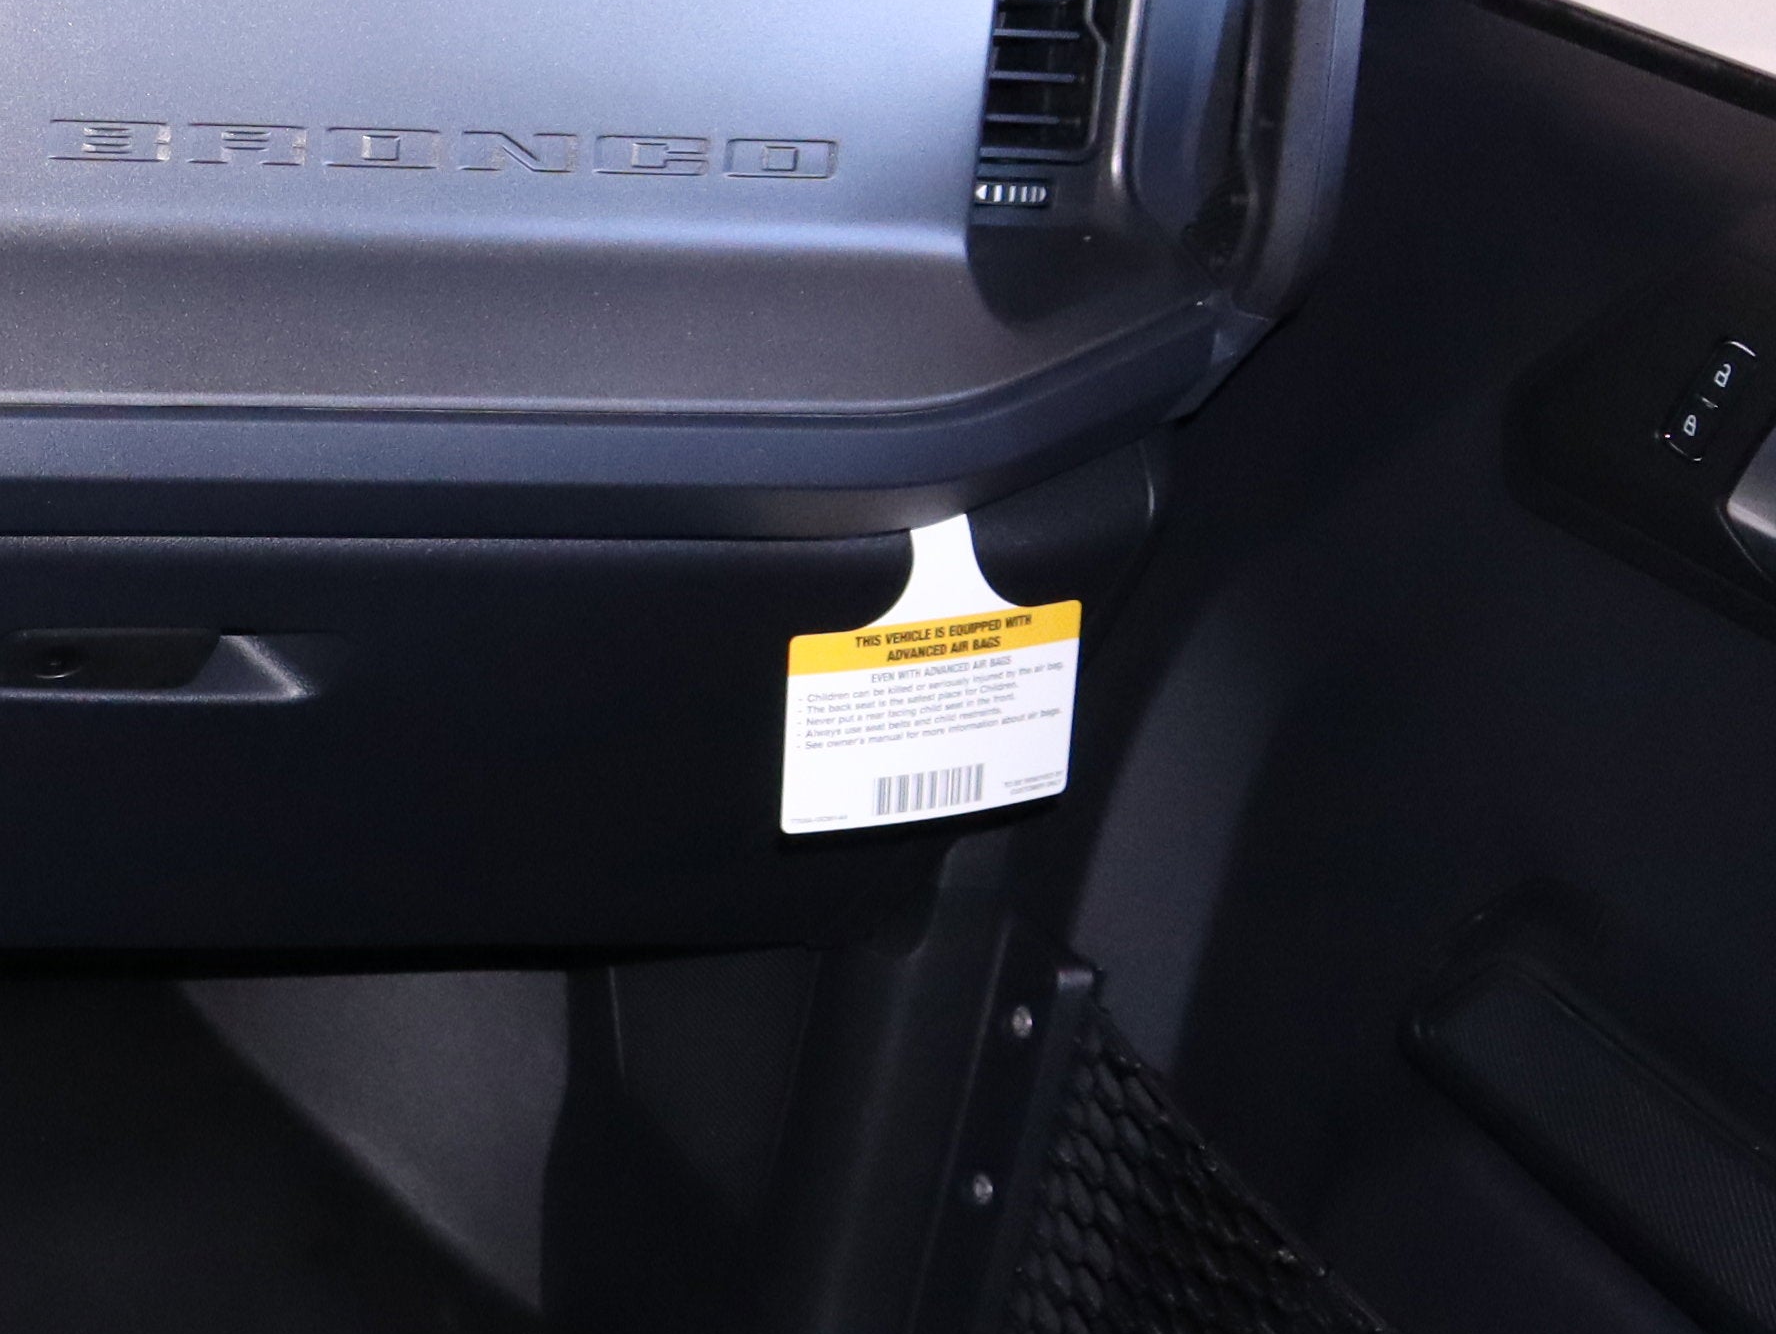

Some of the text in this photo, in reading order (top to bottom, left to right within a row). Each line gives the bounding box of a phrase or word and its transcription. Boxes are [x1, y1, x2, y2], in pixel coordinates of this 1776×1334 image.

[47, 117, 839, 180] BRONCO
[855, 614, 1032, 648] THIS VEHICLE IS EQUIPPED WITH
[886, 636, 1001, 662] ADVANCED AIR BAGS
[871, 655, 1012, 683] EVEN WITH ADVANCED AIR BAGS
